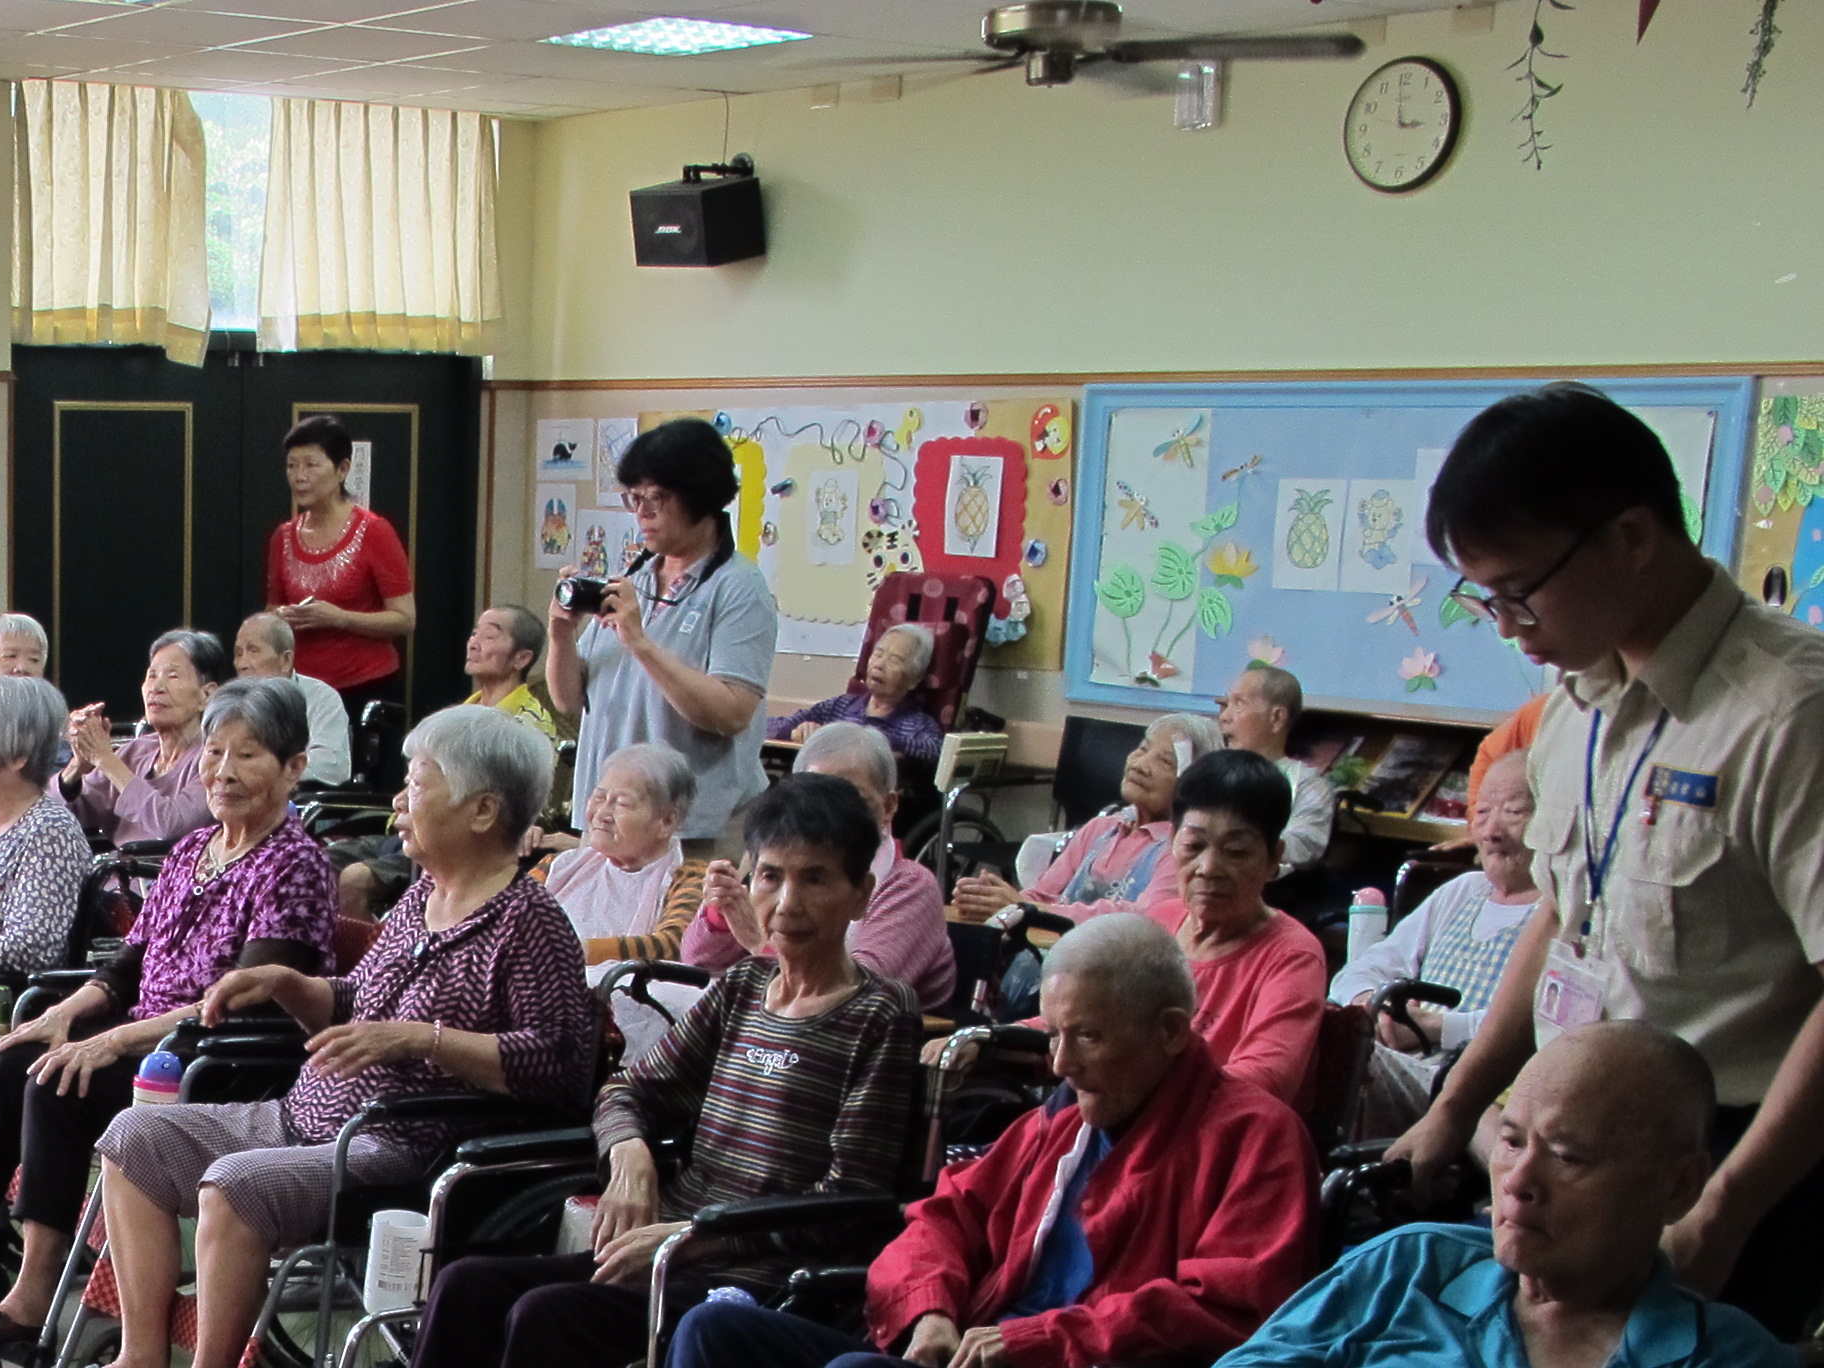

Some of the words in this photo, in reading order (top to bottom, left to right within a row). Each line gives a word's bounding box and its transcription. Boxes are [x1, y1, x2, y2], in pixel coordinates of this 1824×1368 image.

[1398, 73, 1412, 86] 12
[1379, 80, 1389, 95] 11
[1433, 90, 1444, 104] 2
[1359, 123, 1368, 139] 9
[1375, 161, 1384, 174] 7
[1415, 155, 1426, 170] 5
[1394, 165, 1405, 179] 6
